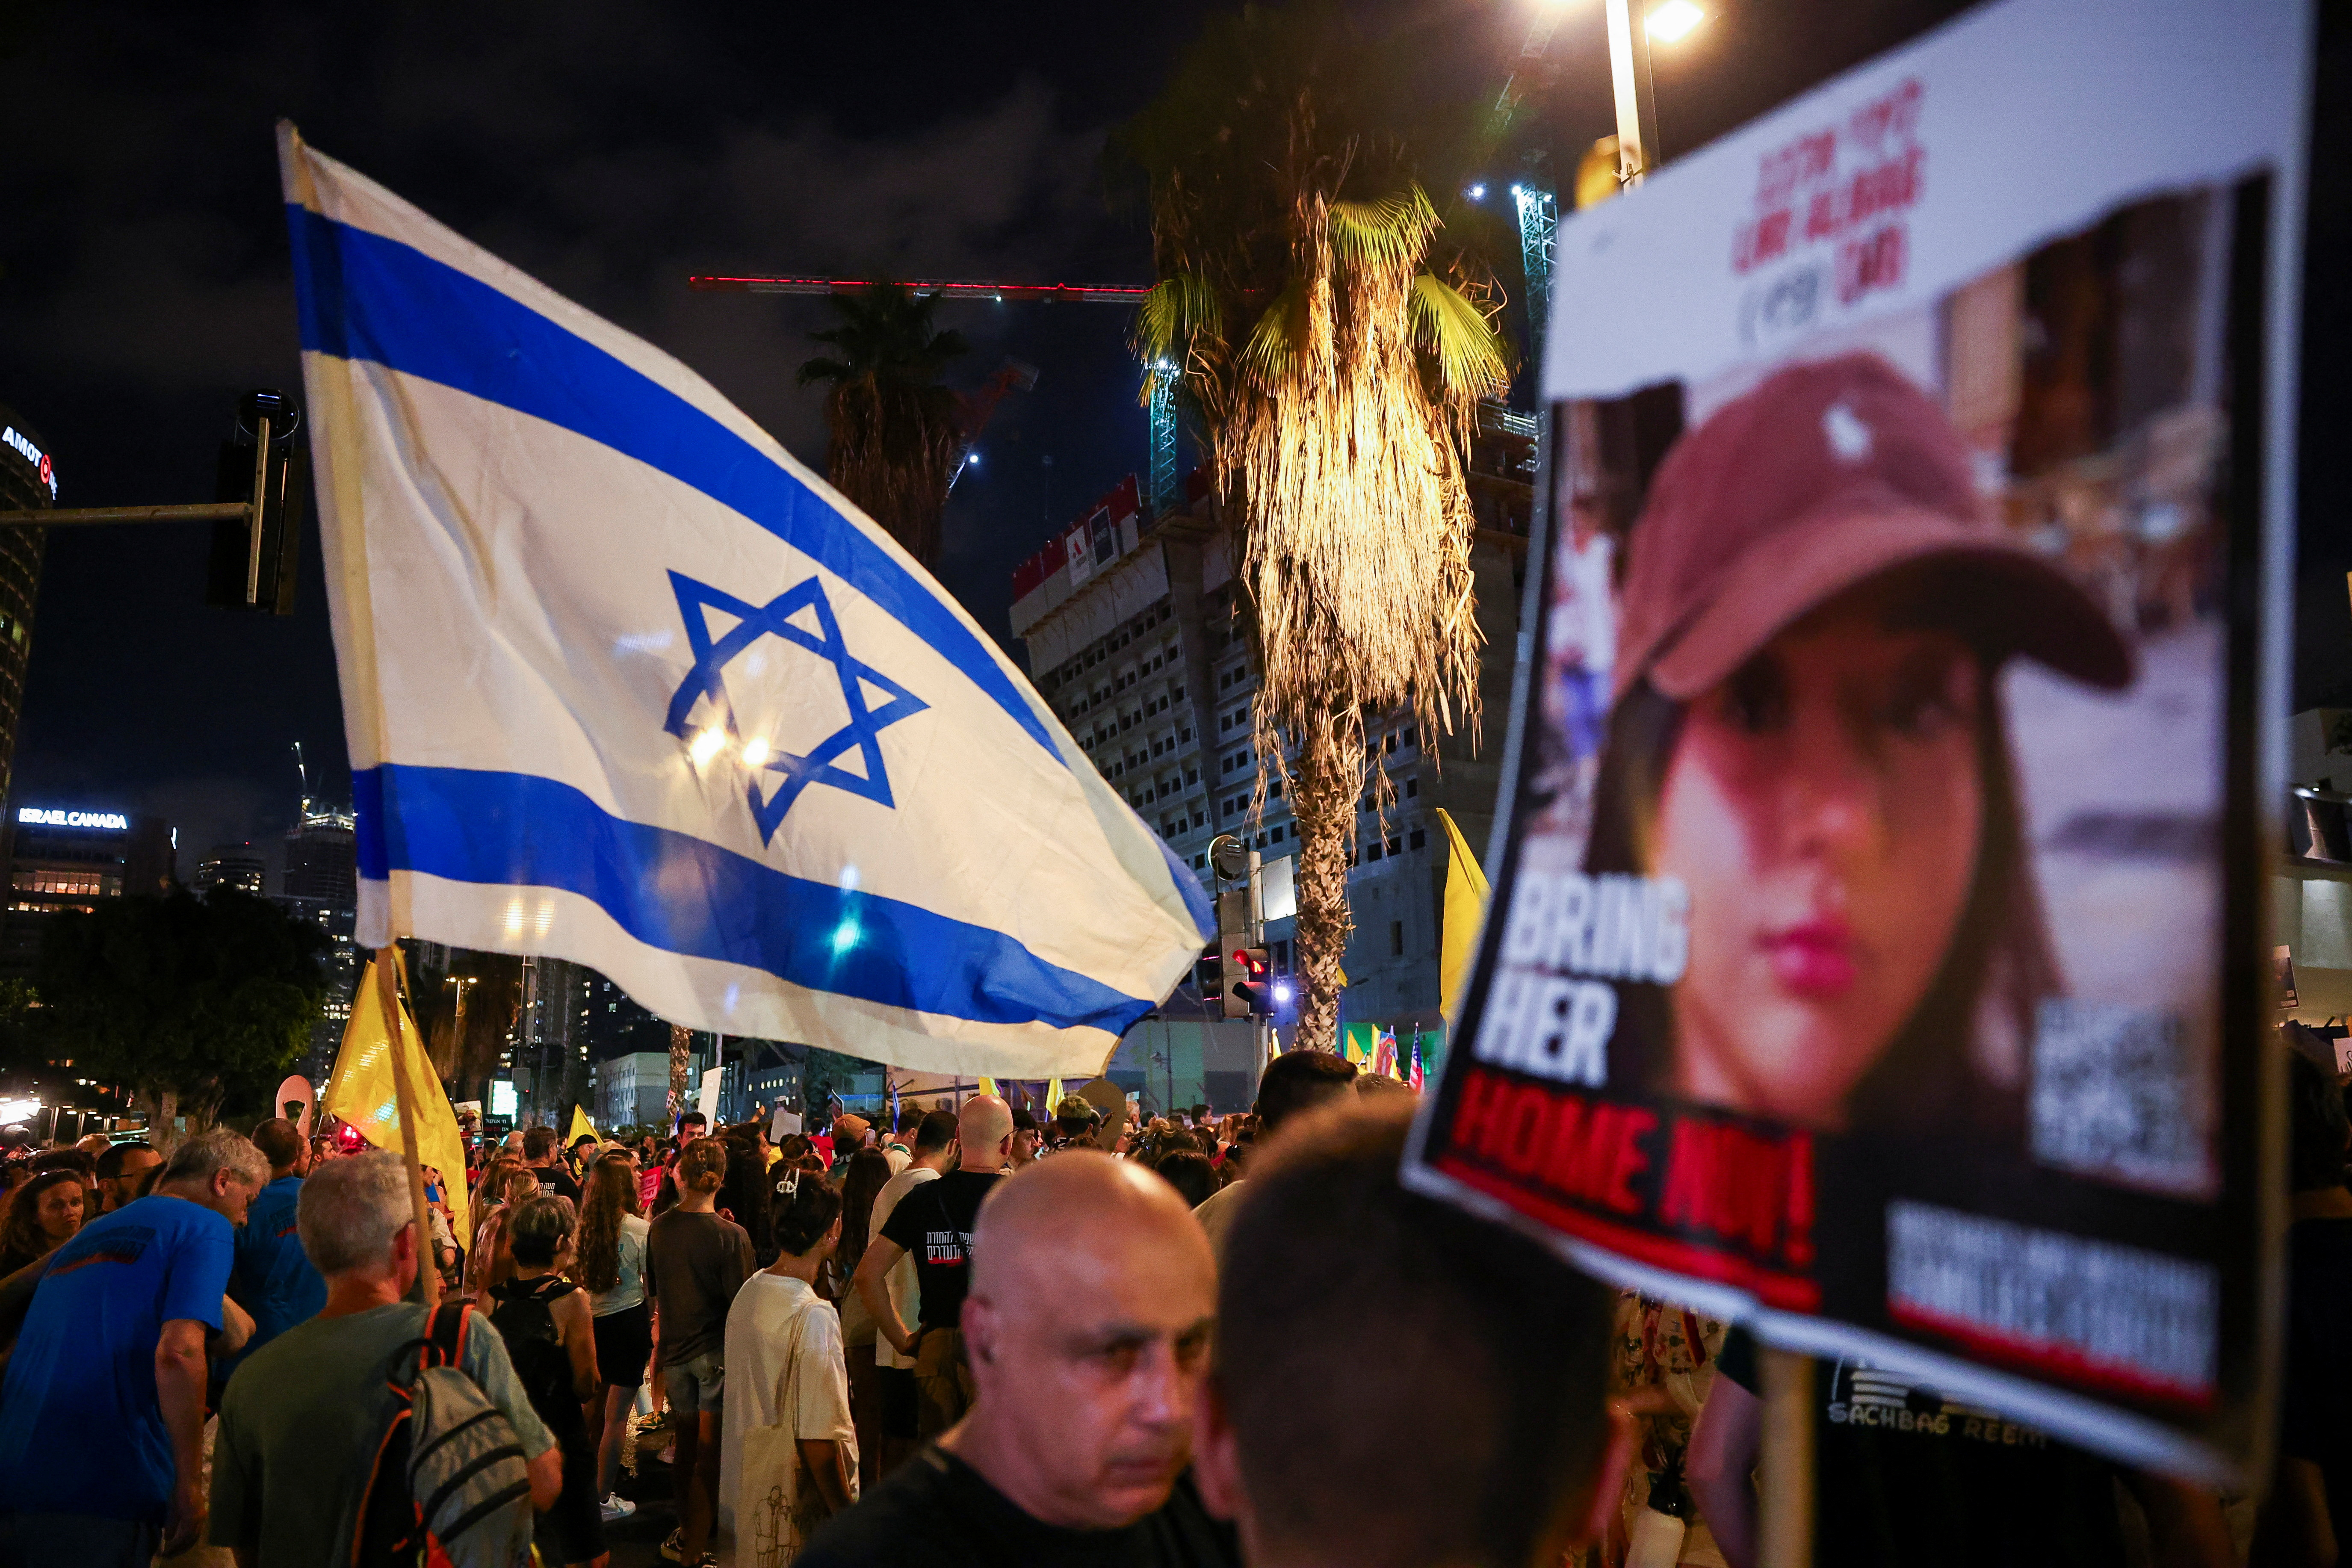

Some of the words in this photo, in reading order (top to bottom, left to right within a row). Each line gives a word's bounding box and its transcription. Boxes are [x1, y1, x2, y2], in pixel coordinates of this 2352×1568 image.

[2, 426, 42, 467] AMOT
[19, 808, 68, 825] ISRAEL
[68, 811, 127, 829] CANADA
[1503, 871, 1690, 986] BRING
[1472, 966, 1619, 1089] HER
[1450, 1068, 1659, 1216] HOME
